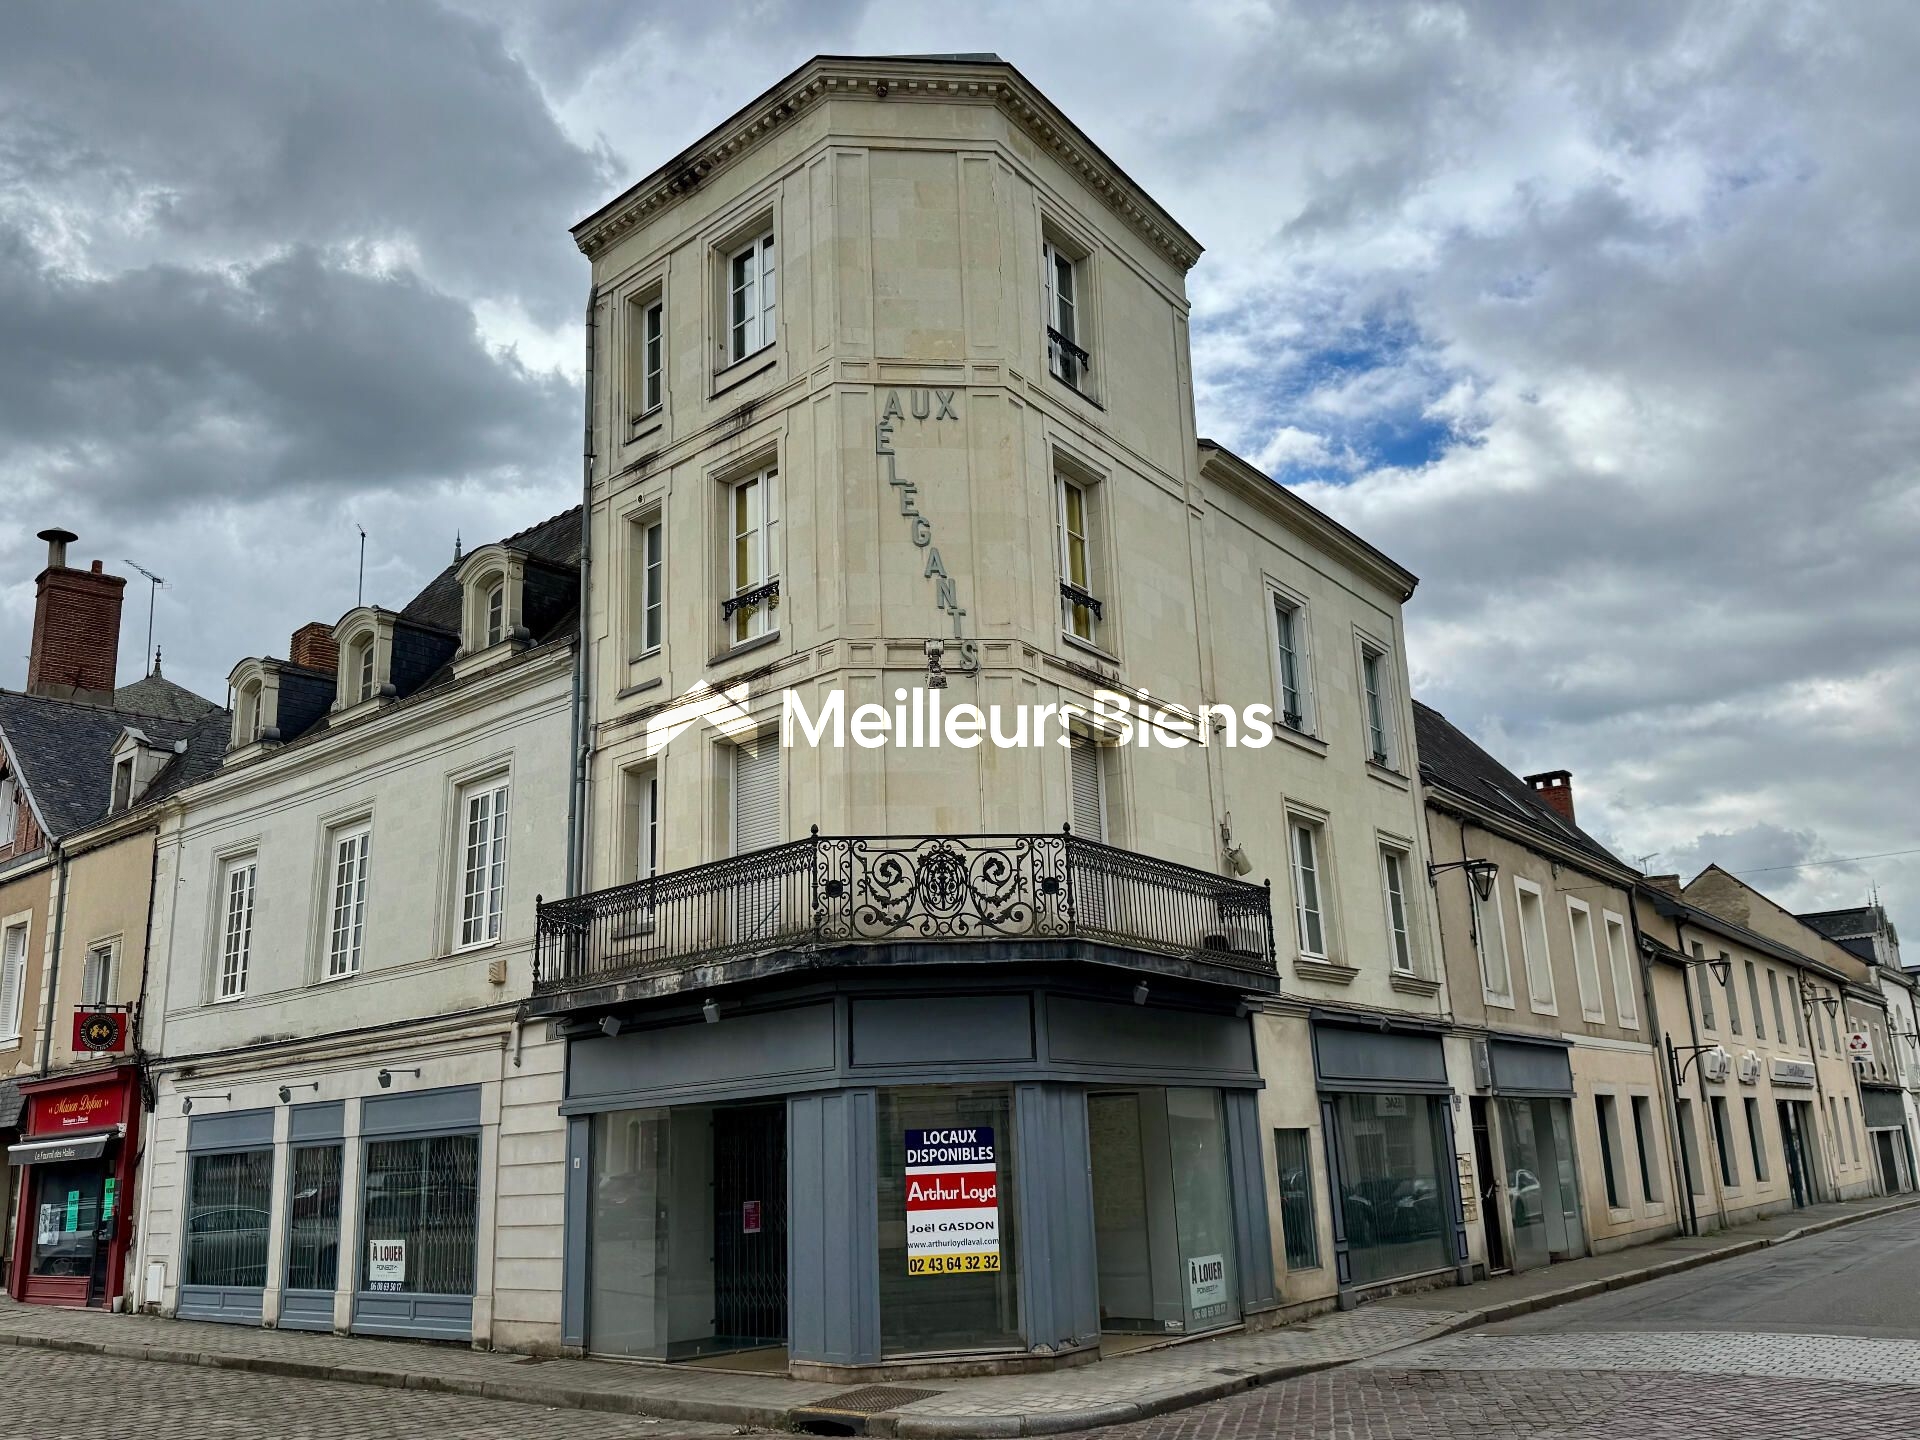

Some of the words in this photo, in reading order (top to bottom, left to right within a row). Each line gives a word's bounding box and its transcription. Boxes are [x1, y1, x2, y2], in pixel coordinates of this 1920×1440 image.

[883, 389, 958, 420] AUX
[54, 1097, 78, 1114] Maison
[923, 1129, 977, 1145] LOCAUX
[34, 1151, 40, 1160] Le
[40, 1149, 54, 1159] Fournil
[54, 1149, 62, 1158] des
[62, 1147, 76, 1157] Halles
[907, 1146, 994, 1163] DISPONIBLES
[908, 1178, 960, 1202] Arthur
[960, 1177, 997, 1203] Loyd
[909, 1223, 935, 1234] Joël
[938, 1221, 995, 1232] GASDON
[372, 1242, 378, 1261] À
[380, 1245, 403, 1261] LOUER
[907, 1237, 1000, 1249] www.arthurloydlaval.com
[909, 1258, 925, 1273] 02
[928, 1257, 943, 1272] 43
[946, 1256, 962, 1271] 64
[965, 1255, 980, 1270] 32
[983, 1254, 999, 1269] 32
[1191, 1261, 1197, 1284] À
[1199, 1261, 1223, 1283] LOUER
